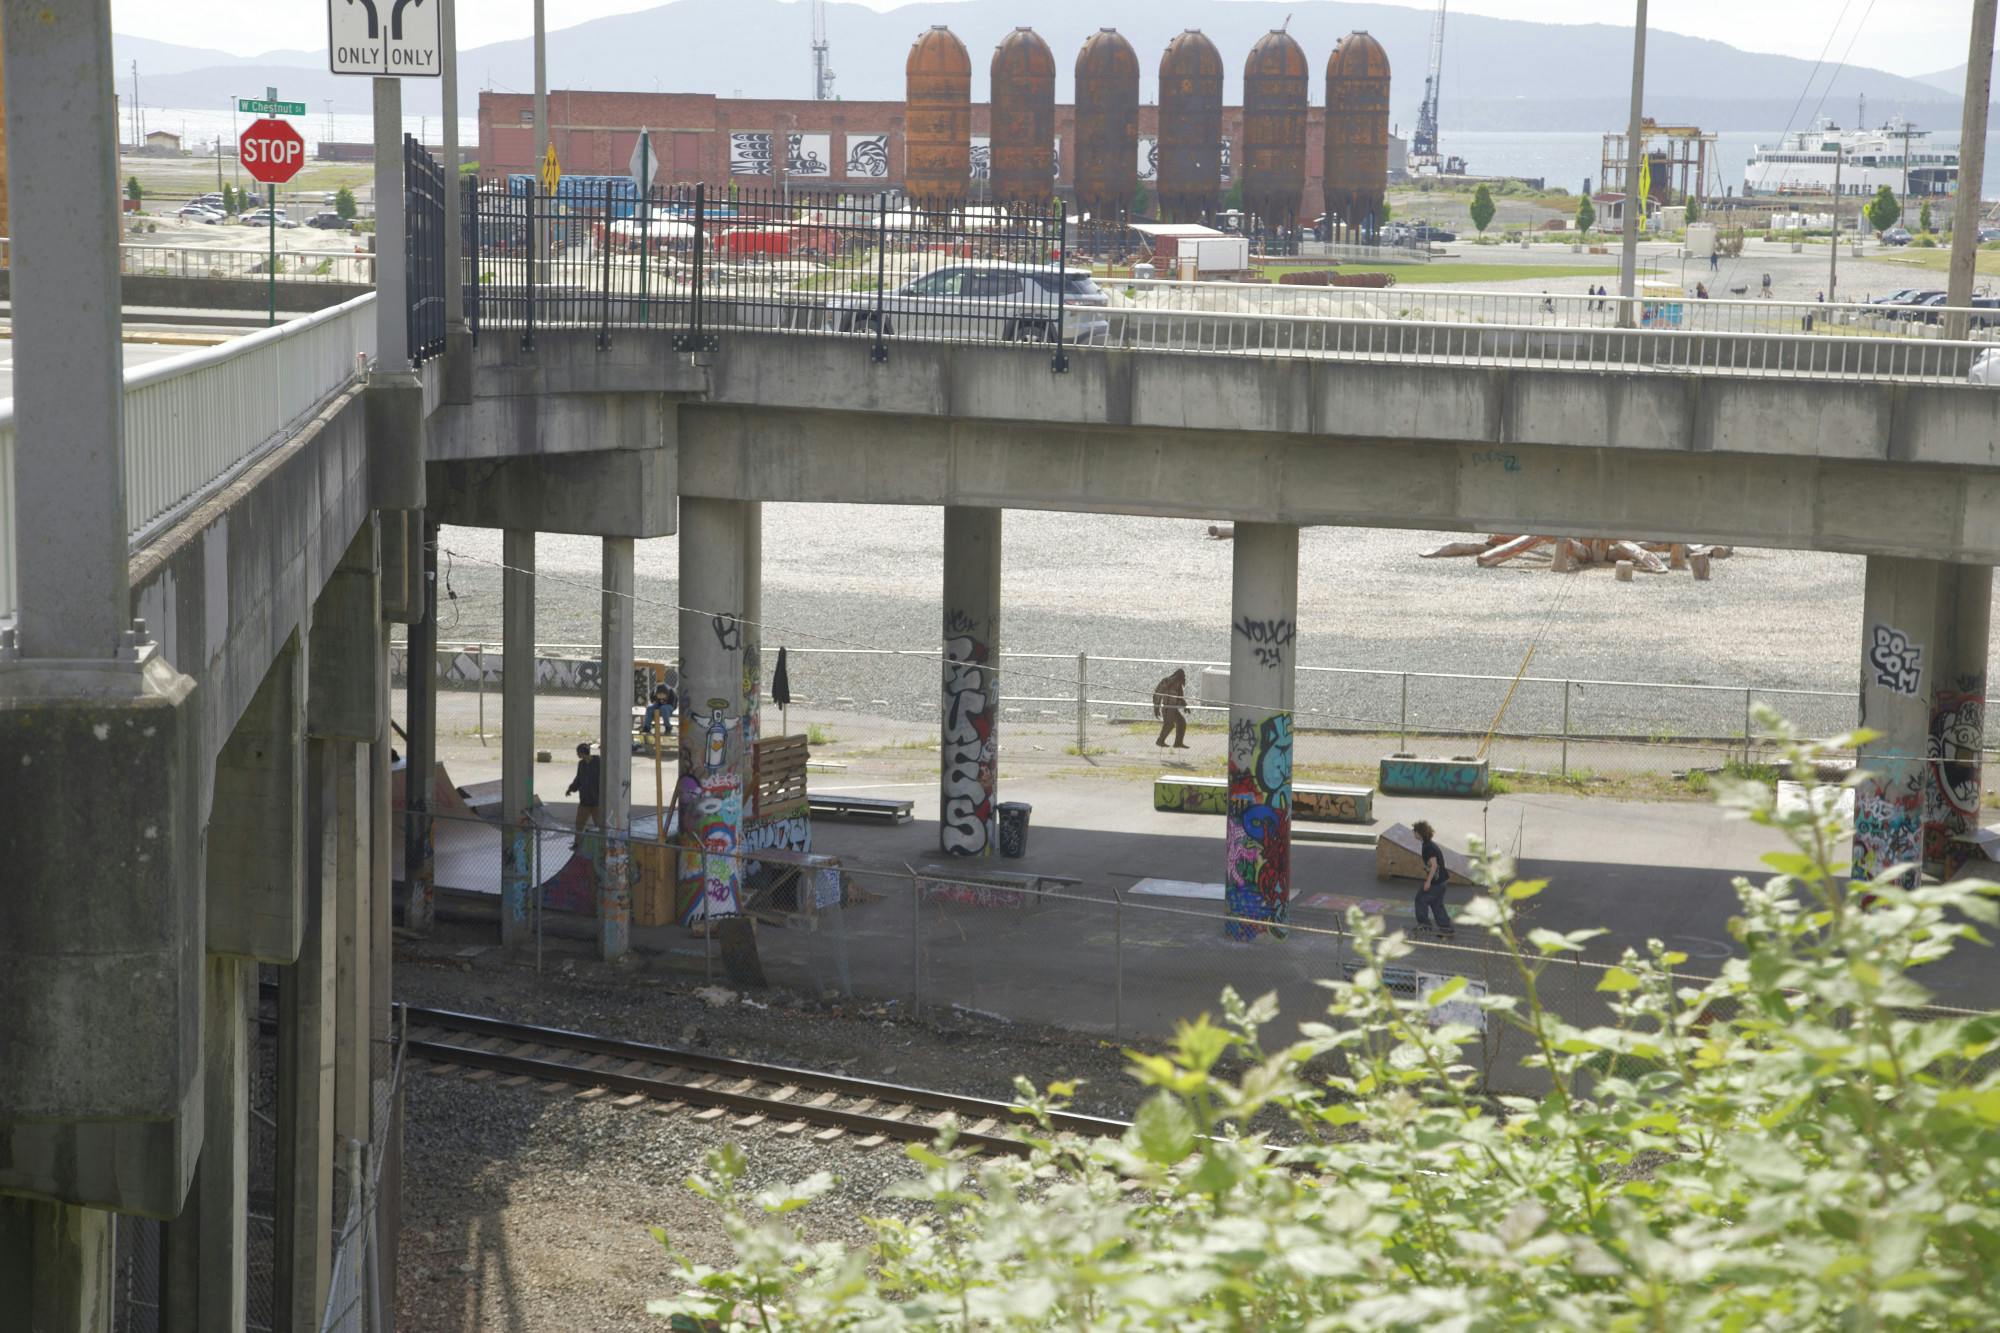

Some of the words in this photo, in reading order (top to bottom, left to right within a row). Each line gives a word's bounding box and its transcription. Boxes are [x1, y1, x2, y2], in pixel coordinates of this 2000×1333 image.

[338, 46, 379, 64] ONLY
[392, 48, 433, 66] ONLY
[241, 100, 249, 111] W
[251, 101, 293, 113] Chestnut
[244, 138, 301, 164] STOP
[1873, 626, 1920, 671] DOT
[1870, 645, 1920, 693] COM
